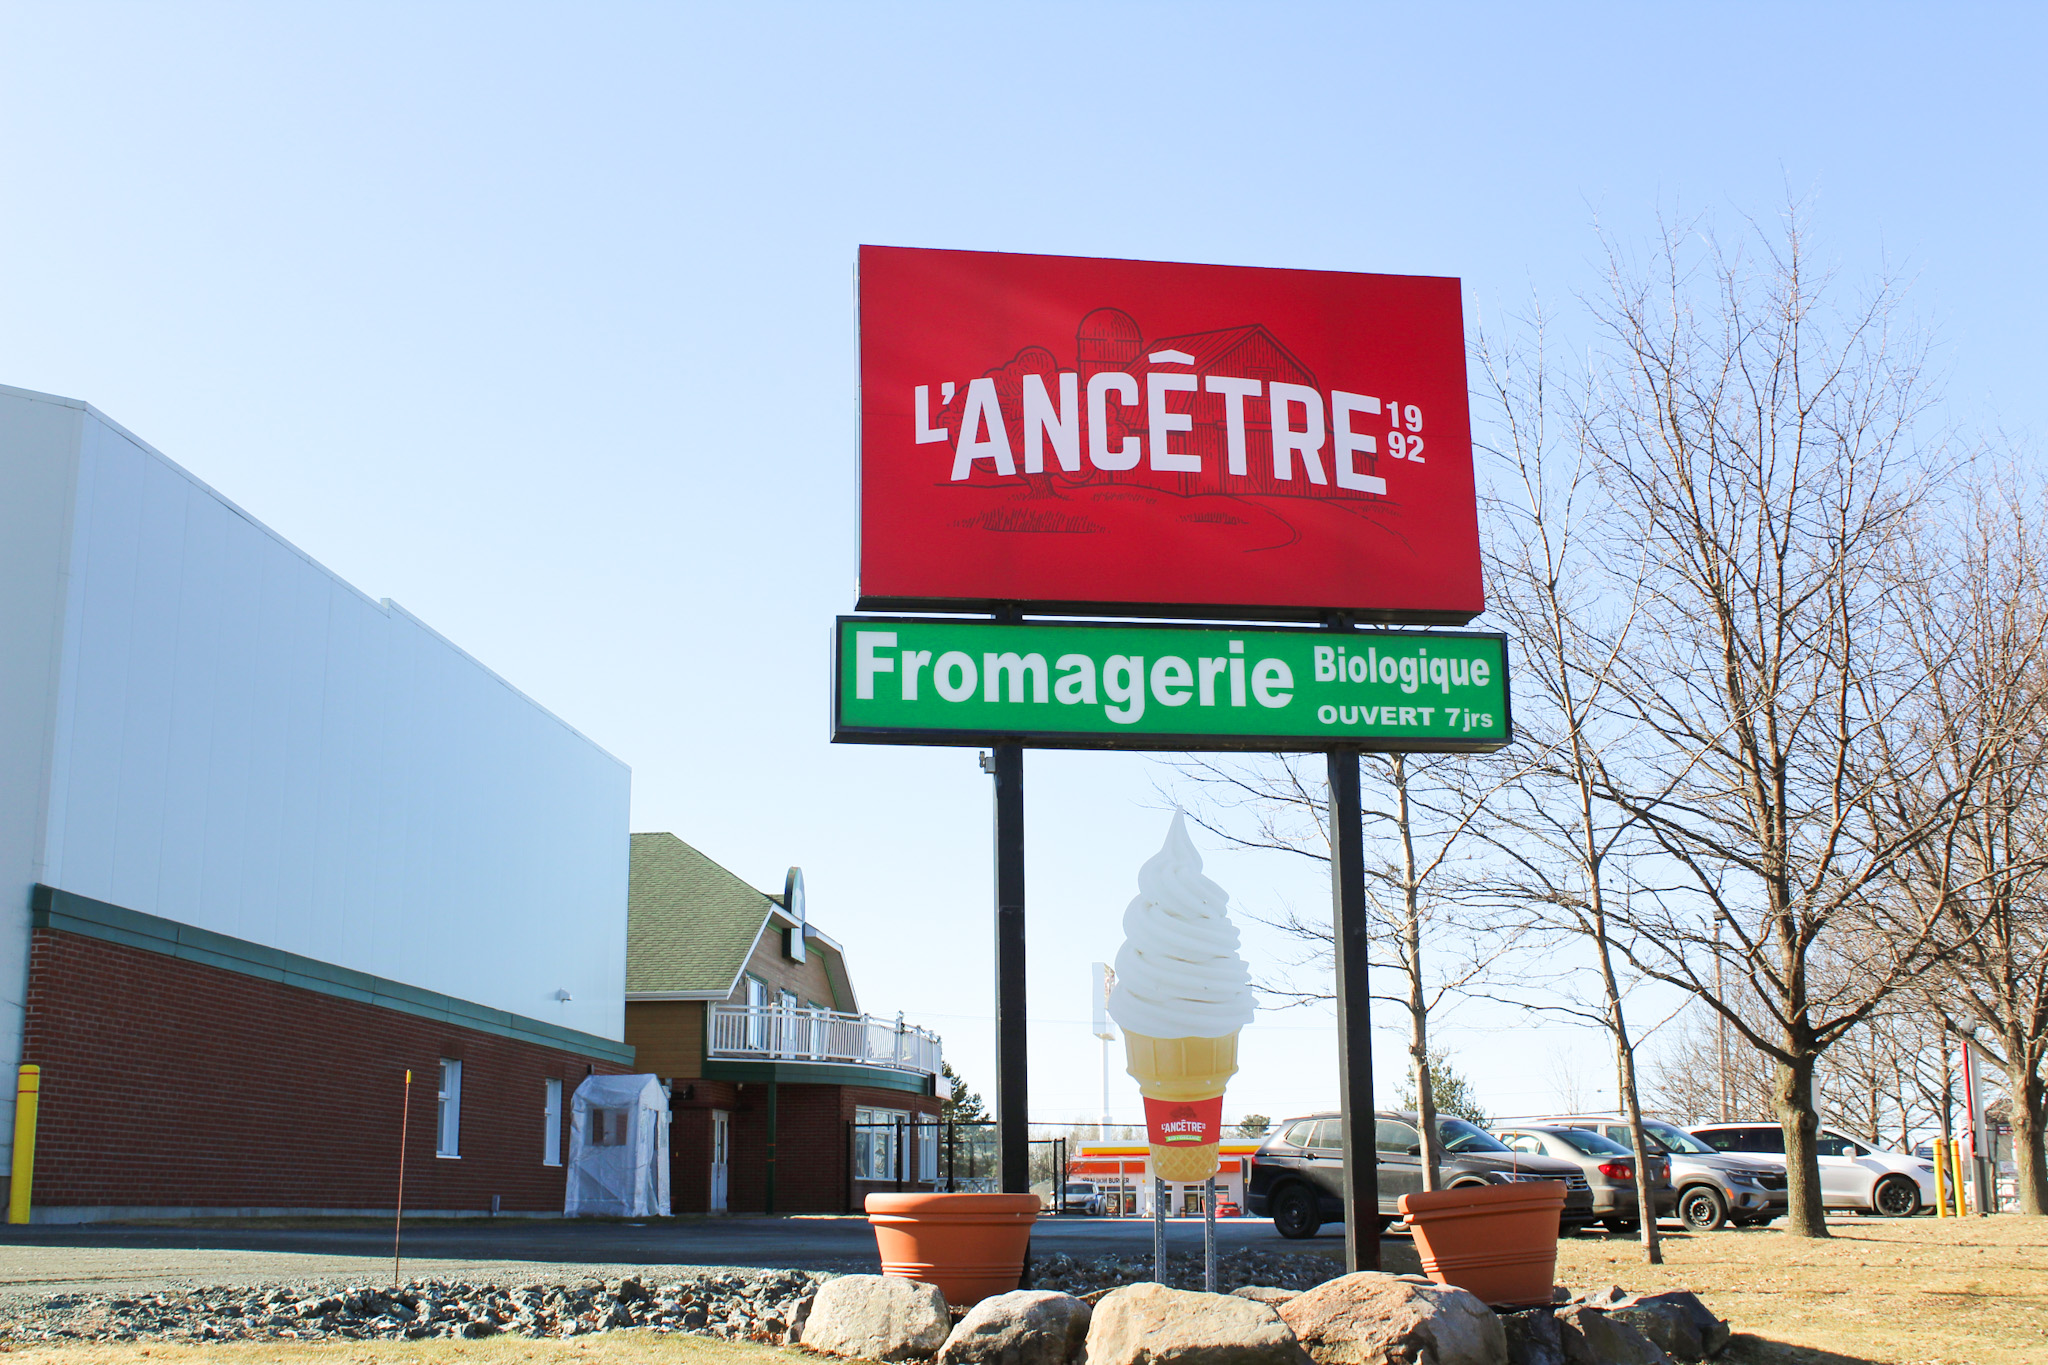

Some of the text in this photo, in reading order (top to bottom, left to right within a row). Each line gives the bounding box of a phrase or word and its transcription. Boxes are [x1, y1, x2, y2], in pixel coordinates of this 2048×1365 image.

[914, 348, 1387, 496] L'ANCÊTRE
[1386, 401, 1423, 433] 19
[1387, 431, 1426, 464] 92
[855, 630, 1295, 725] Fromagerie
[1313, 645, 1491, 694] Biologique
[1317, 704, 1494, 733] OUVERT 7 jrs
